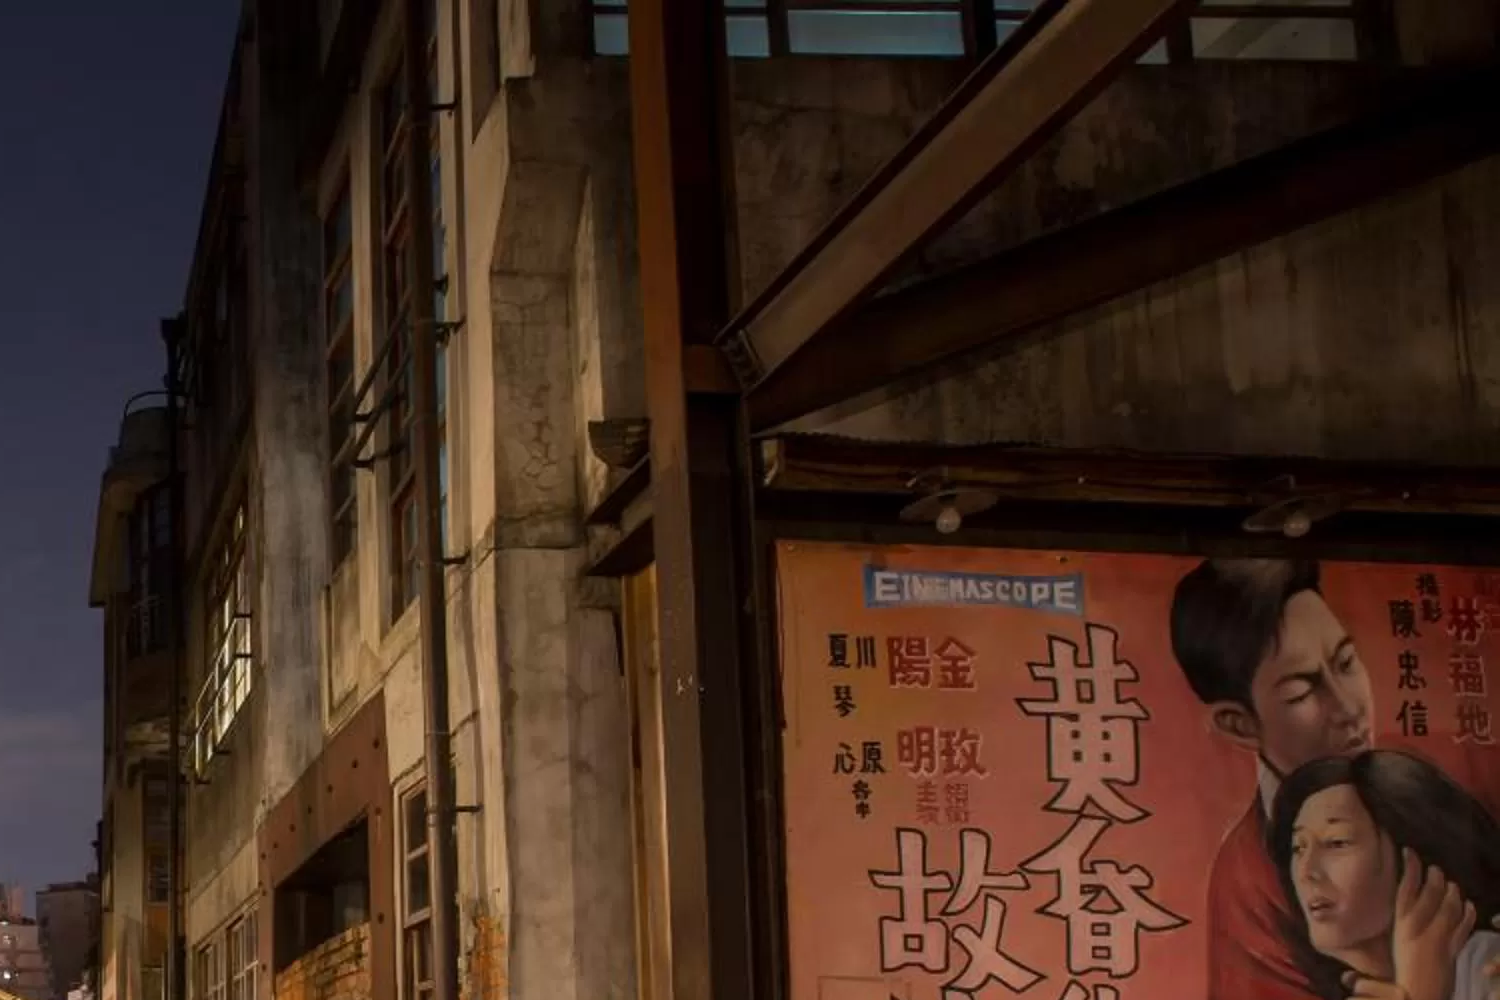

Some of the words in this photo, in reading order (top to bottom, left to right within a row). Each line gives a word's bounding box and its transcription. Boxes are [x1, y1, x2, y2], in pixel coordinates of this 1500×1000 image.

[827, 633, 857, 774] 夏琴心
[855, 635, 887, 774] 川原
[886, 635, 938, 780] 陽明
[934, 635, 991, 781] 金玫
[1388, 599, 1429, 737] 陳忠信
[1447, 596, 1497, 745] 林福地
